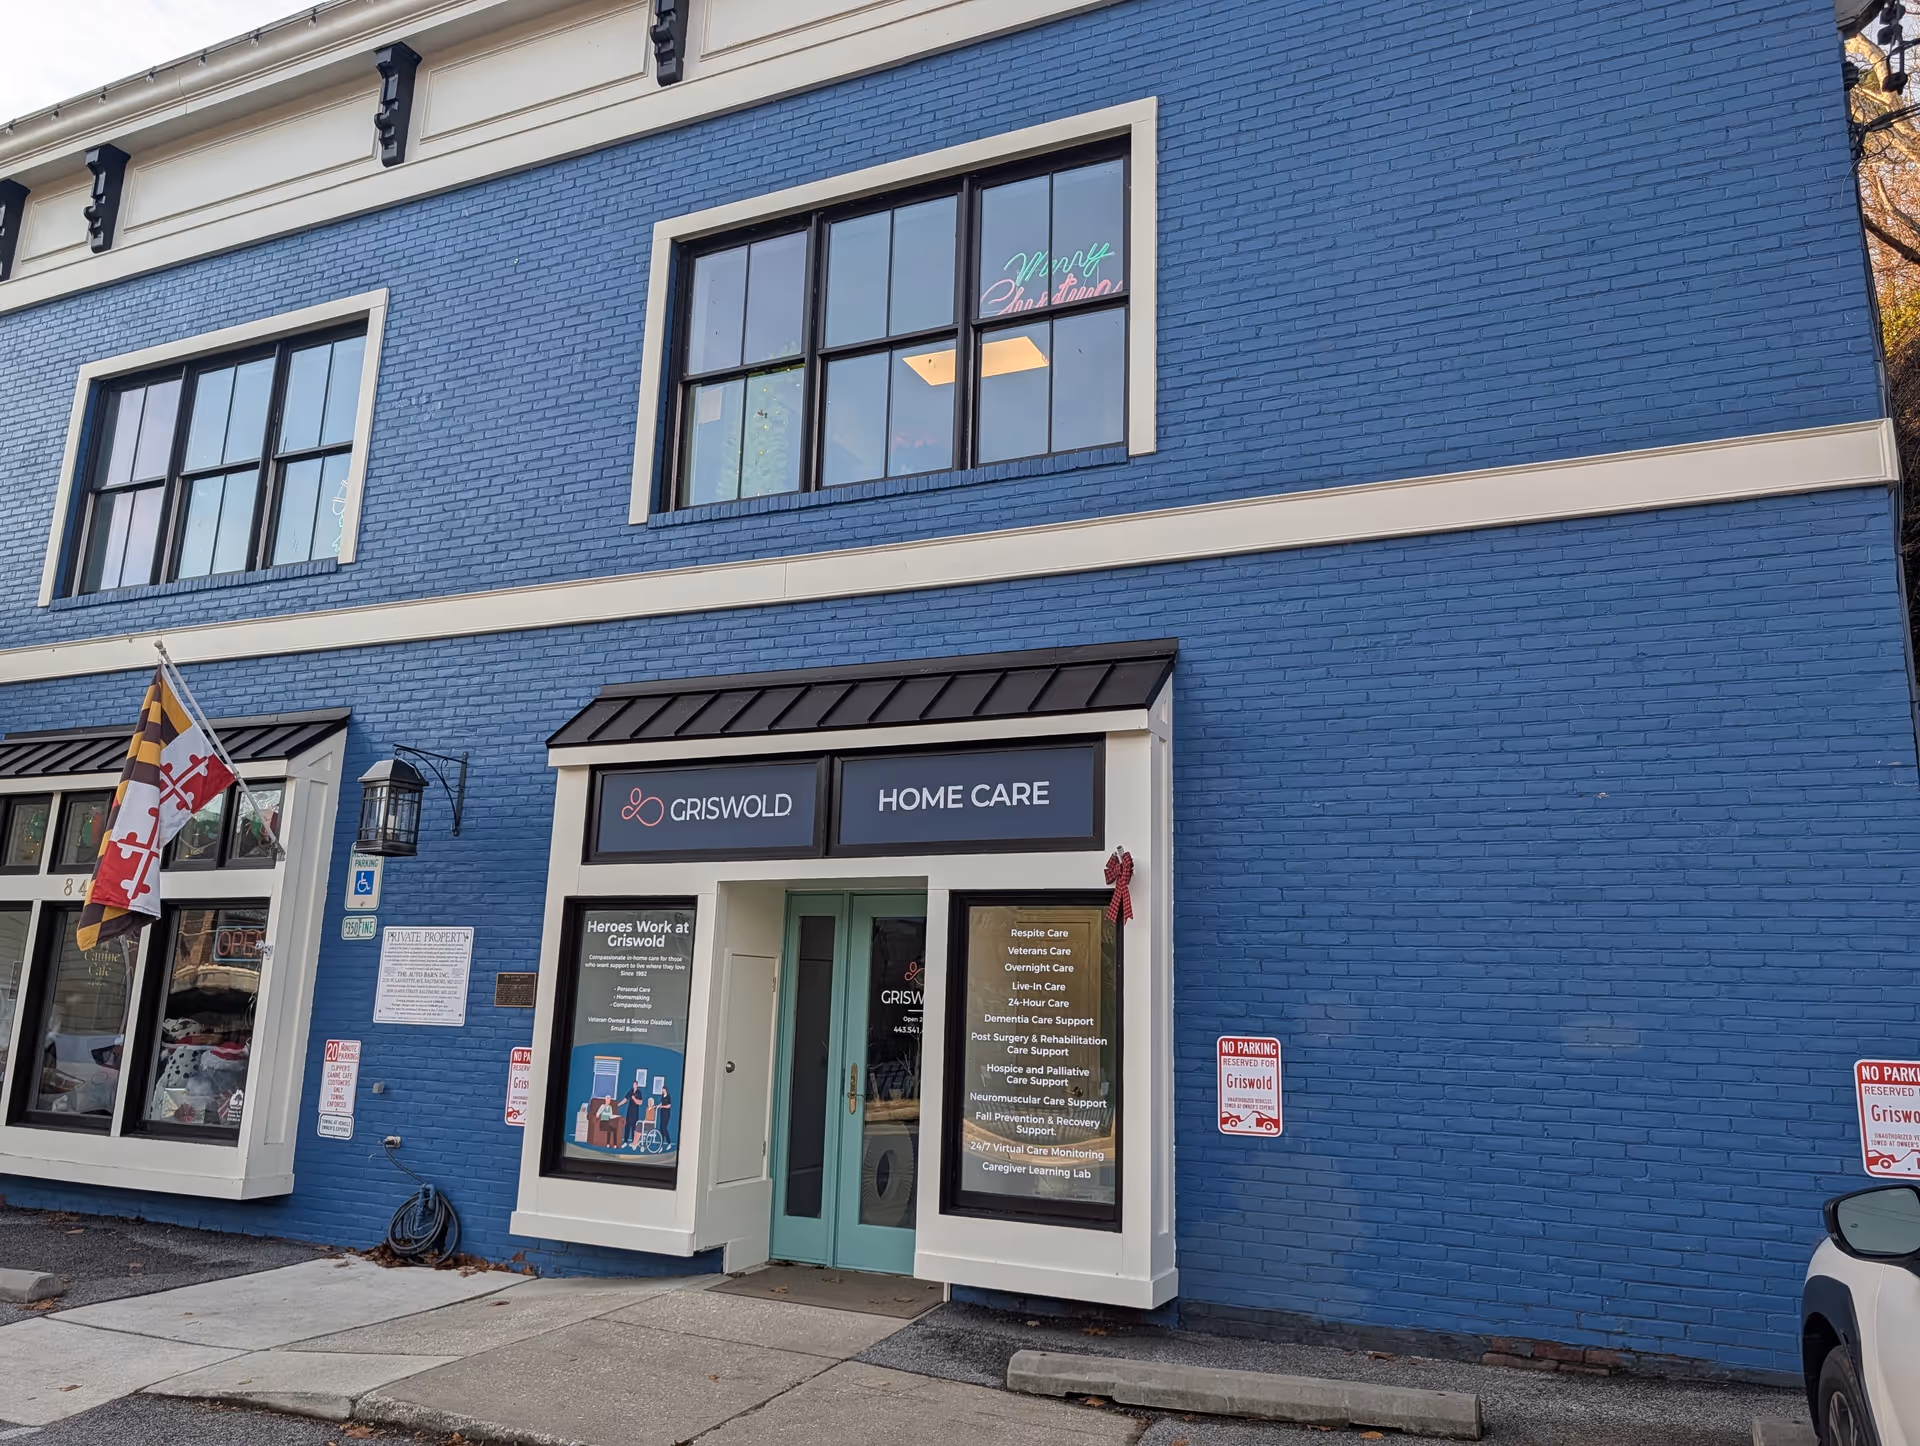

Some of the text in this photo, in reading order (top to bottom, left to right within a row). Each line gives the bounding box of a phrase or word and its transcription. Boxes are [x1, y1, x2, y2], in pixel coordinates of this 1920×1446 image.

[1003, 242, 1116, 287] Merry
[878, 781, 1051, 812] HOME CARE
[670, 793, 793, 822] GRISWOLD
[354, 858, 379, 868] PARKING
[359, 920, 374, 935] FINE
[587, 920, 690, 934] Heroes Work at
[387, 931, 470, 943] PRIVATE PROPERTY
[1010, 929, 1069, 939] Respite Care
[607, 934, 665, 948] Griswold
[1008, 946, 1072, 956] Veterans Care
[588, 954, 626, 962] Compassionate
[1004, 963, 1074, 973] Overnight Care
[1012, 982, 1066, 991] Live-In Care
[616, 994, 650, 1002] Homemaking
[1008, 998, 1070, 1008] 24-Hour Care
[612, 1002, 652, 1010] Companionship
[650, 1018, 673, 1026] Disabled
[984, 1014, 1094, 1027] Dementia Care Support
[971, 1032, 1108, 1046] Post Surgery & Rehabilitation
[326, 1042, 338, 1061] 20
[340, 1044, 358, 1052] MINUTE
[1007, 1045, 1069, 1057] Care Support
[1222, 1040, 1277, 1056] NO PARKING
[339, 1052, 358, 1061] PARKING
[513, 1051, 522, 1062] NO
[330, 1064, 351, 1072] CLIPPER'S
[1223, 1057, 1275, 1068] RESERVED FOR
[986, 1063, 1090, 1077] Hospice and Palliative
[1861, 1065, 1880, 1081] NO
[342, 1072, 353, 1080] CAFE
[1006, 1076, 1069, 1087] Care Support
[327, 1079, 351, 1087] CUSTOMERS
[1226, 1073, 1273, 1091] Griswold
[1864, 1085, 1915, 1097] RESERVED
[330, 1093, 345, 1101] TOWING
[969, 1092, 1107, 1109] Neuromuscular Care Support
[326, 1101, 347, 1109] ENFORCED
[975, 1111, 1100, 1130] Fall Prevention & Recovery
[1016, 1125, 1057, 1136] Support.
[1874, 1132, 1913, 1141] UNAUTHORIZED
[1871, 1139, 1888, 1147] TOWED
[1896, 1141, 1920, 1149] OWNER'S
[970, 1141, 1105, 1162] 24/7 Virtual Care Monitoring
[982, 1161, 1091, 1179] Caregiver Learning Lab
